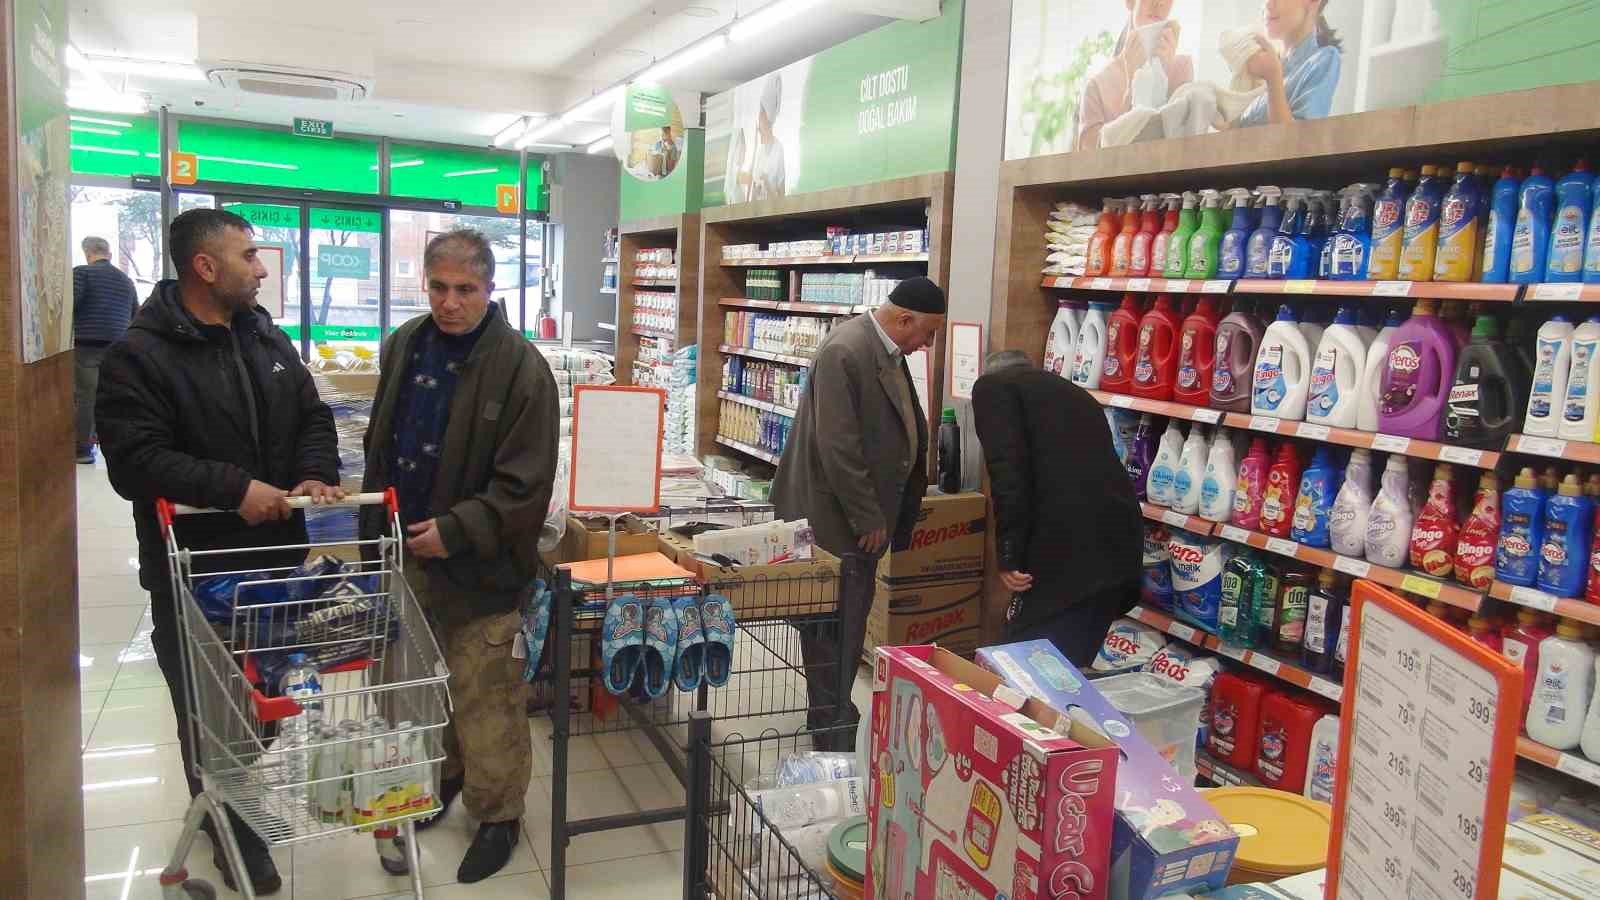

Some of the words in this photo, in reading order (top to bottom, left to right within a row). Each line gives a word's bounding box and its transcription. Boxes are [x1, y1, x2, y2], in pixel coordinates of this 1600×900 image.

[880, 63, 909, 97] DOSTU
[300, 120, 325, 128] EXIT
[887, 95, 918, 127] BAKIM
[177, 160, 192, 177] 2
[1391, 352, 1419, 369] Peros
[910, 520, 970, 550] Renax
[1411, 528, 1443, 541] Bingo
[1457, 543, 1493, 556] Bingo
[906, 606, 965, 642] Renax
[1398, 704, 1409, 725] 79
[1469, 697, 1491, 724] 399
[1388, 752, 1405, 777] 219
[1468, 760, 1483, 783] 29
[1018, 752, 1033, 825] COSMETICS
[1384, 802, 1401, 828] 399
[1457, 813, 1479, 842] 199
[1452, 869, 1474, 900] 299
